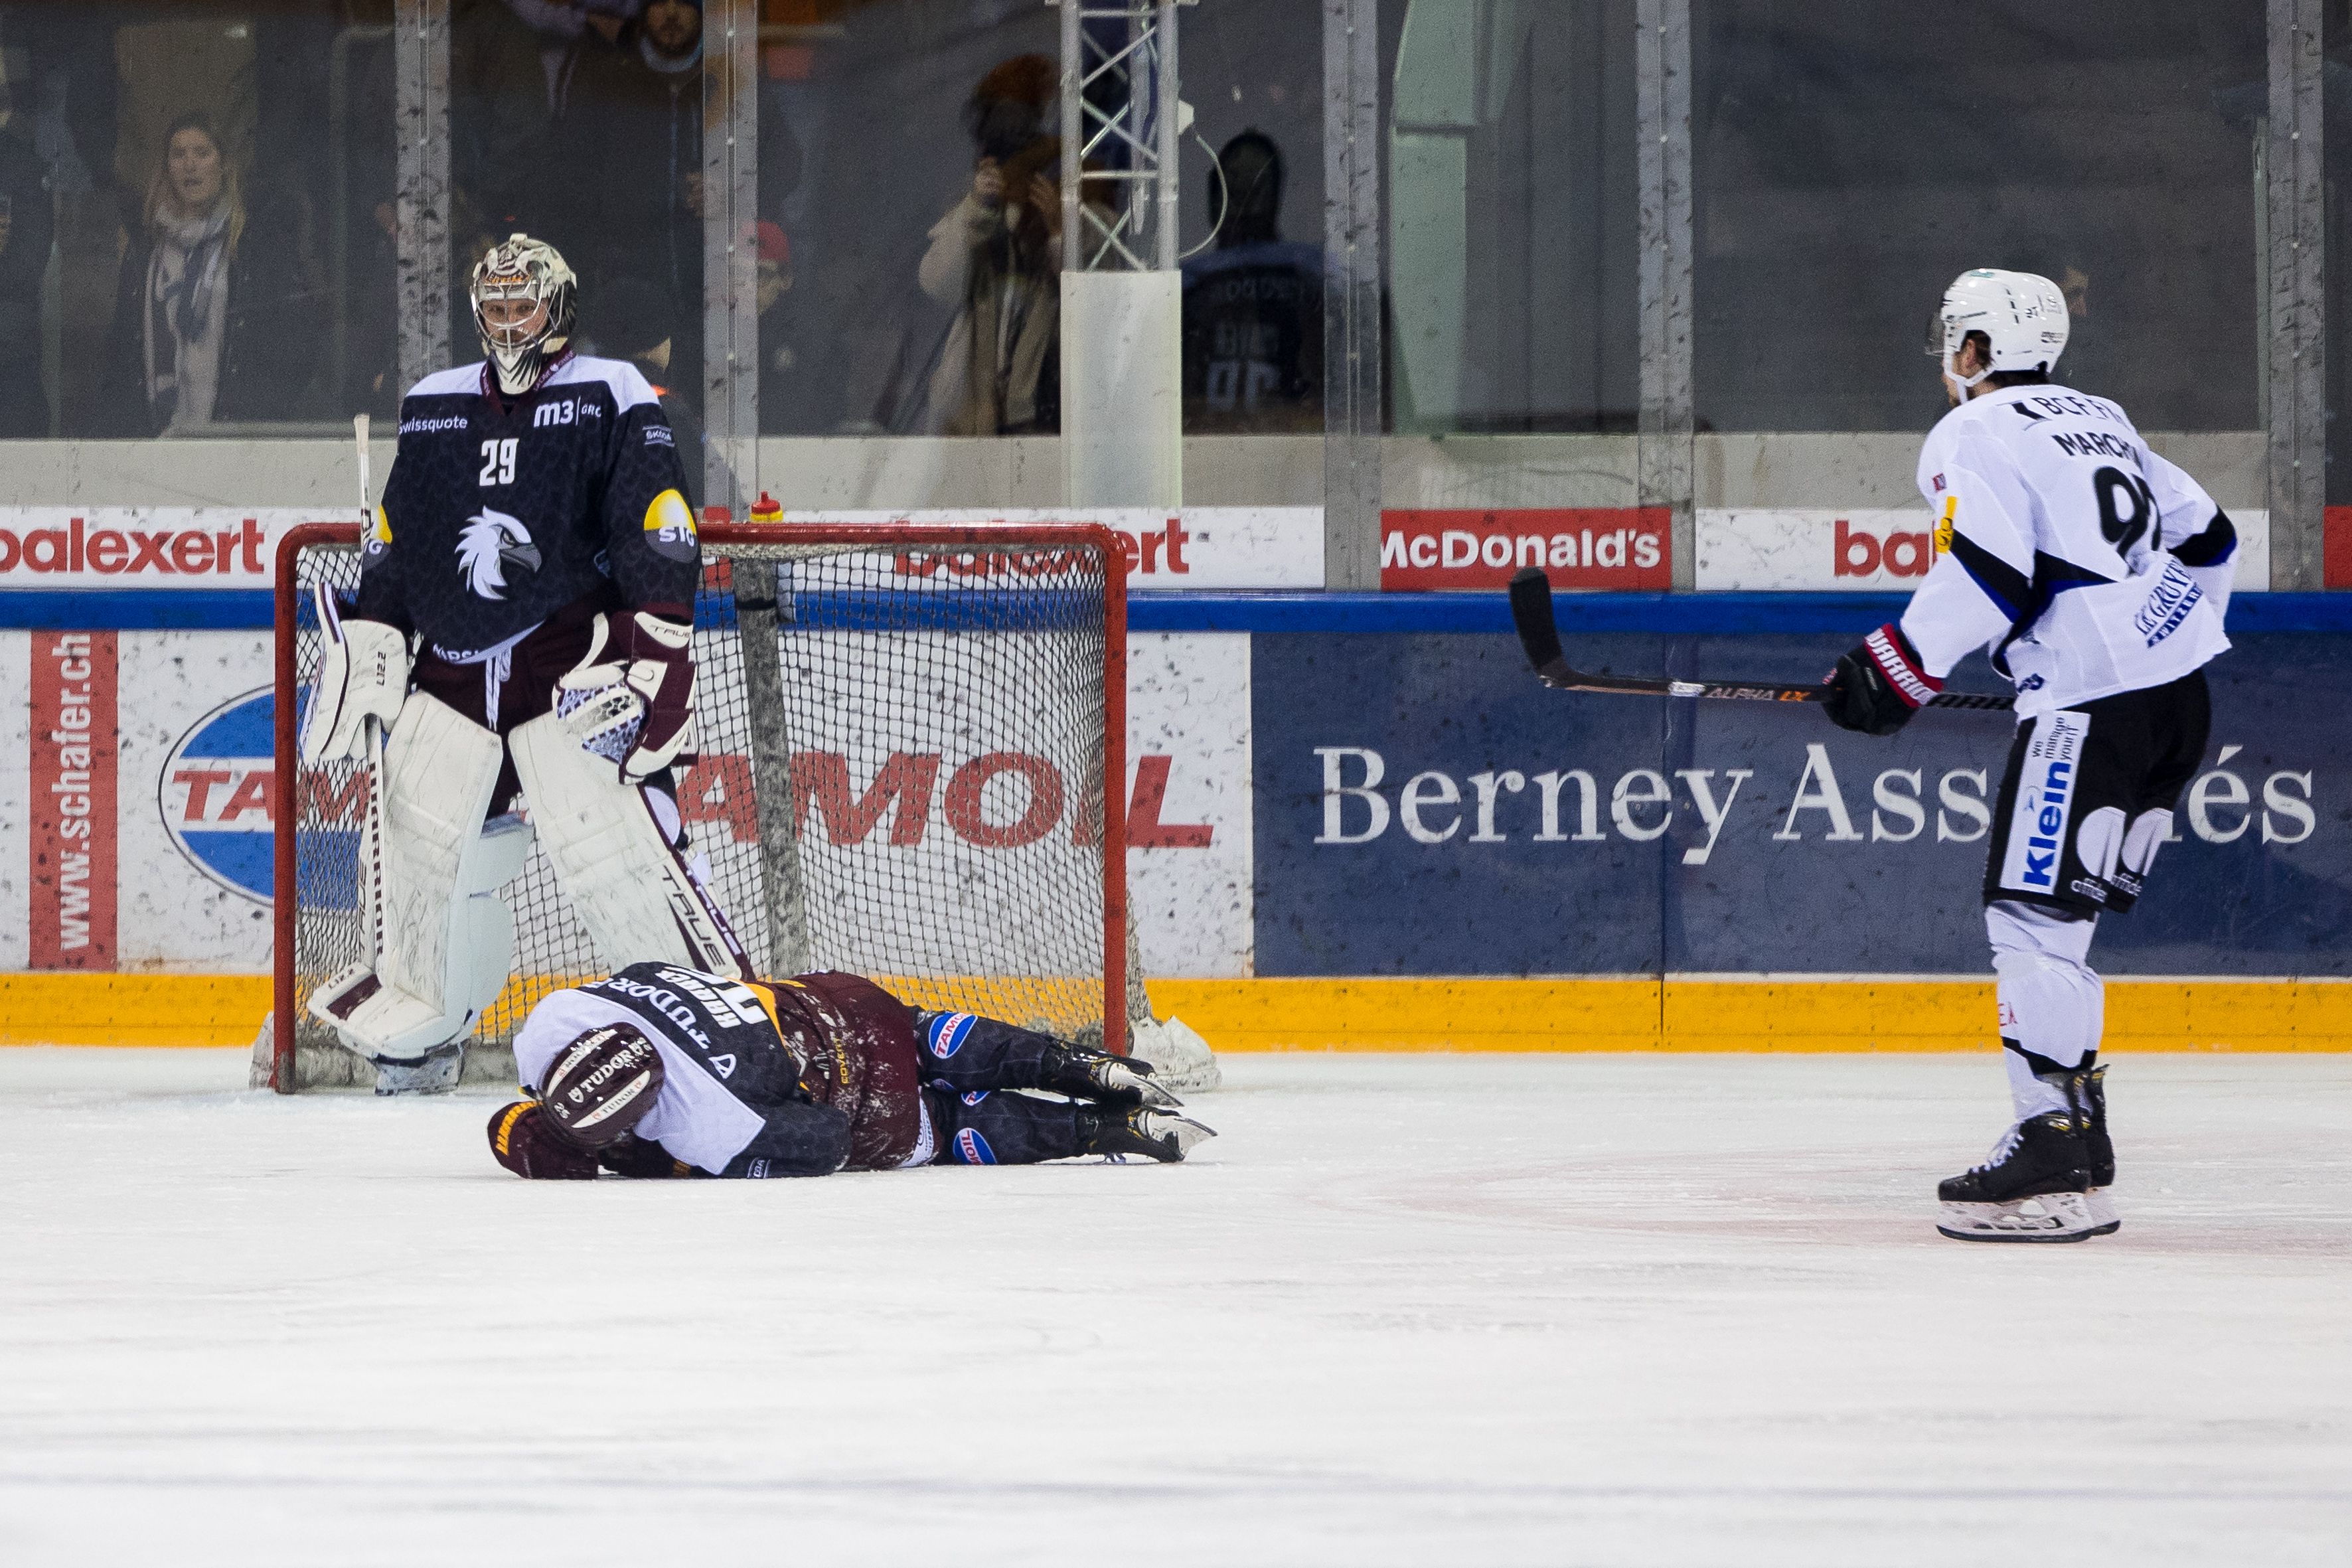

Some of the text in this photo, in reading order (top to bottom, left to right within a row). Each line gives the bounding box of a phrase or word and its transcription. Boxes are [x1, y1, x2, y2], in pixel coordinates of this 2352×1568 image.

[533, 400, 574, 428] m3
[479, 438, 519, 487] 29
[2051, 431, 2144, 474] MARCH
[1381, 528, 1660, 569] McDonald's
[51, 633, 91, 951] www.schafer.ch
[1314, 744, 1753, 865] Berney
[2022, 761, 2073, 888] Klein
[663, 864, 726, 967] TRUE
[607, 977, 711, 1050] TUDOR
[937, 1012, 968, 1056] TAMO
[580, 1049, 635, 1093] TUDOR
